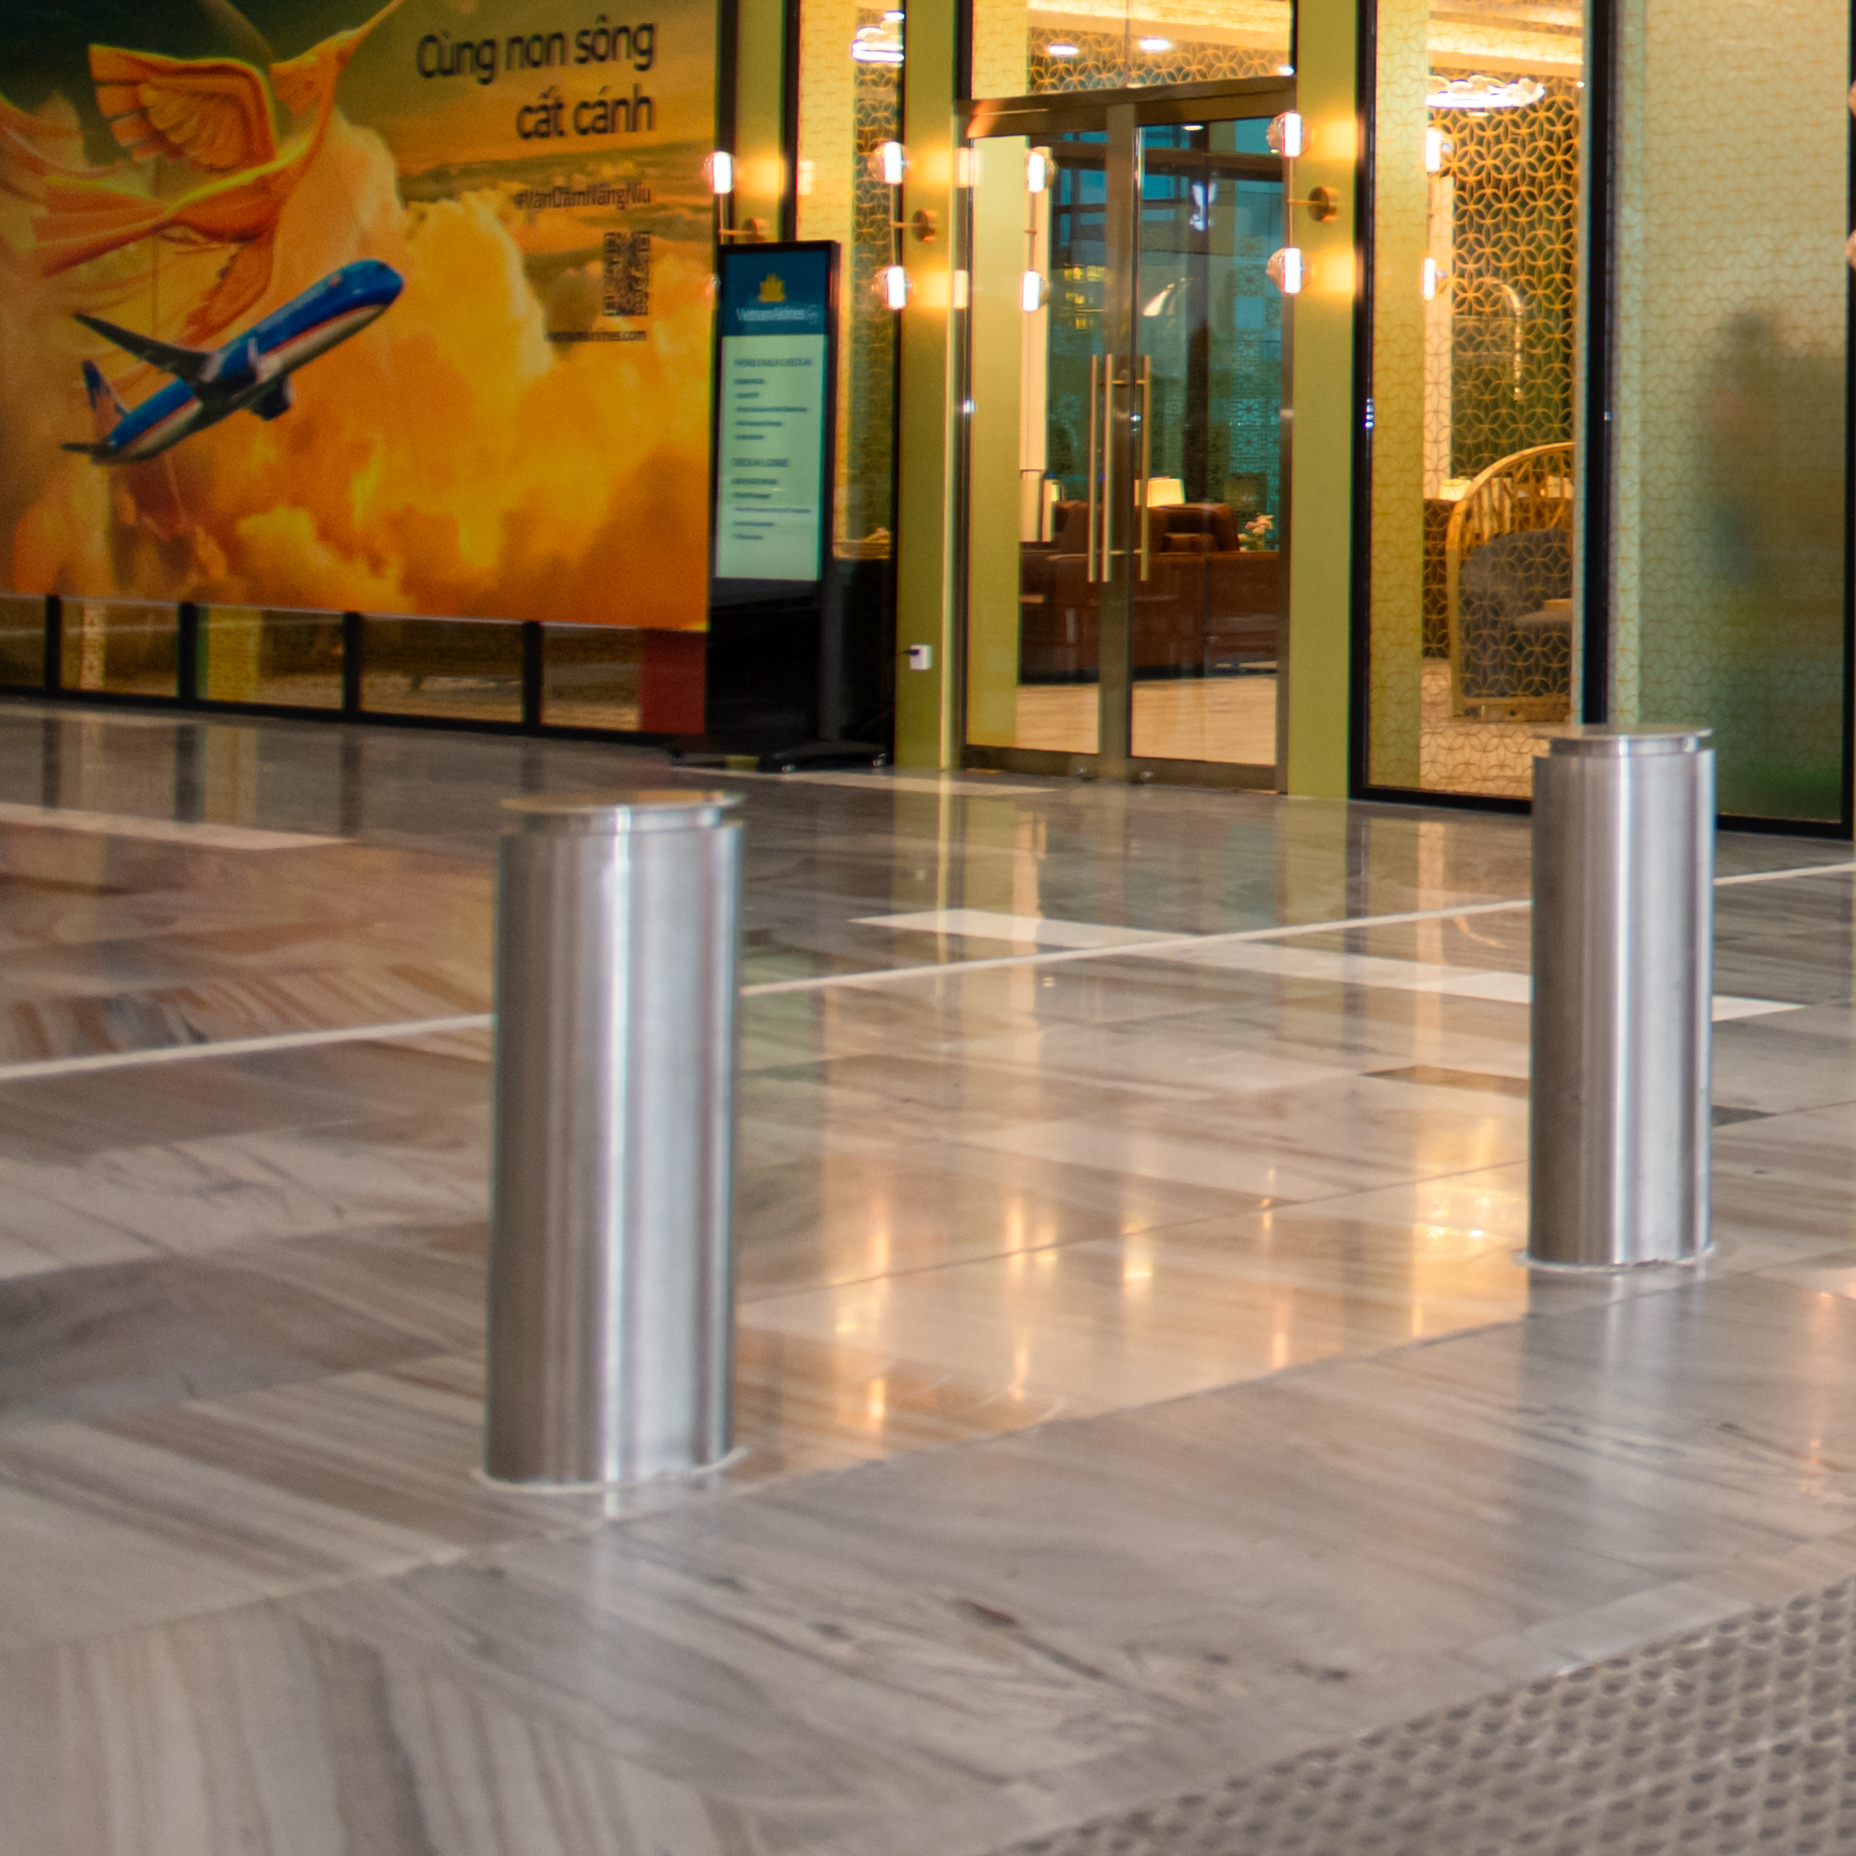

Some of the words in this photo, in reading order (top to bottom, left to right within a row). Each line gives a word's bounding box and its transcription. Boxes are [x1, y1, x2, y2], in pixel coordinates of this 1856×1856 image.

[416, 30, 497, 85] Cùng
[505, 32, 567, 71] non
[574, 13, 656, 72] sông
[516, 84, 565, 140] cất
[572, 82, 656, 136] cánh
